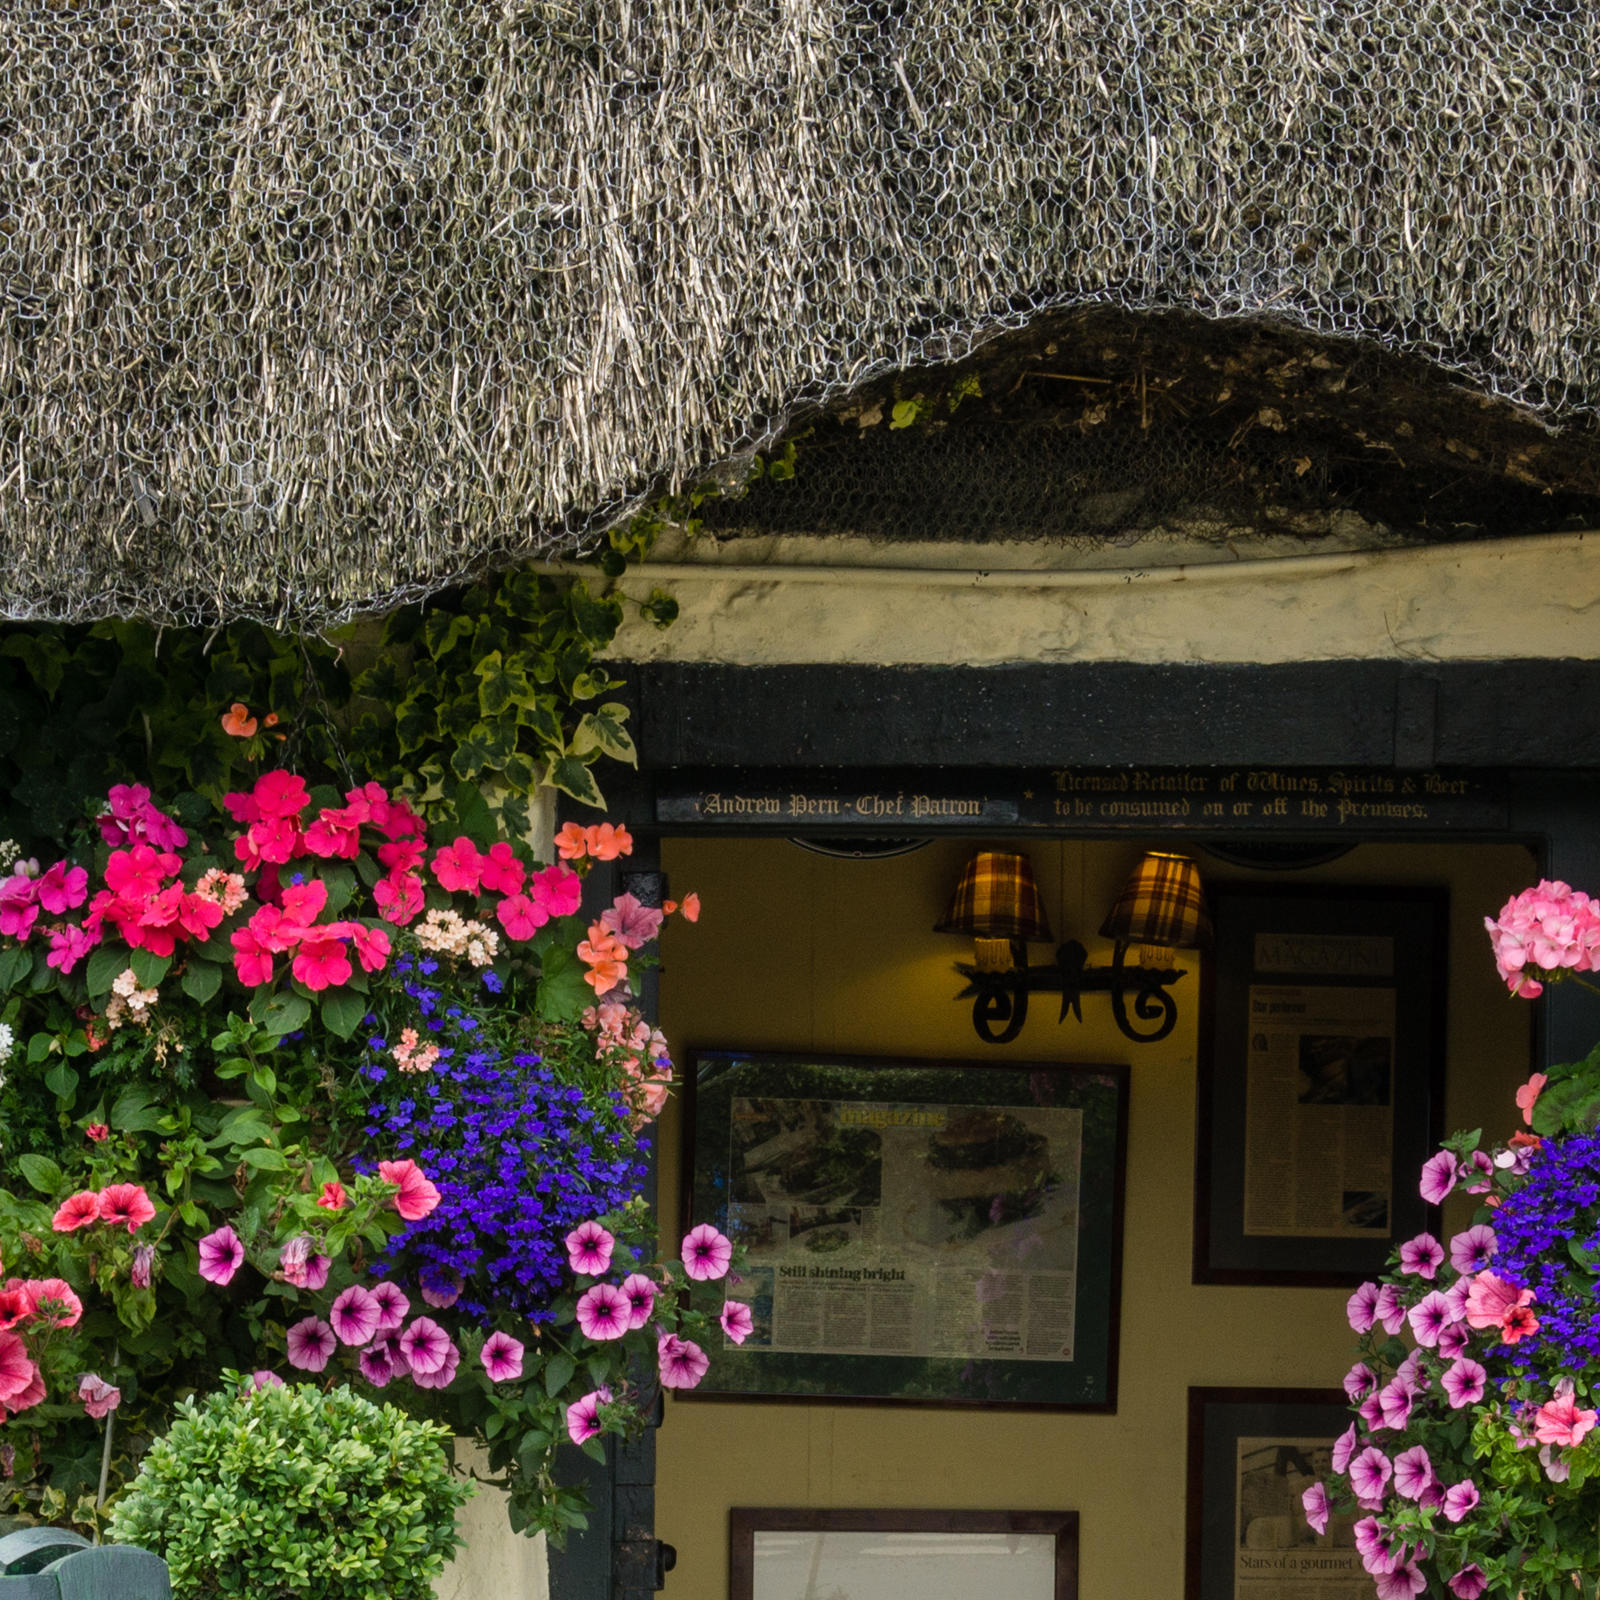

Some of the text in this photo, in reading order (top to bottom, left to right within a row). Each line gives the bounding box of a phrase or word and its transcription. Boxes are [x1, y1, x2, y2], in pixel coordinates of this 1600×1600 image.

[1220, 773, 1240, 793] of
[1400, 778, 1416, 794] &
[703, 792, 780, 814] Andrew
[789, 794, 840, 817] Pern
[856, 792, 903, 817] Chef
[911, 794, 982, 818] Patron
[1053, 797, 1429, 825] to be consumed on or off the Premises.
[779, 1265, 906, 1282] Still shining bright
[1239, 1555, 1271, 1569] Stars
[1274, 1554, 1289, 1569] of
[1289, 1558, 1298, 1569] a
[1300, 1557, 1353, 1573] gourmet
